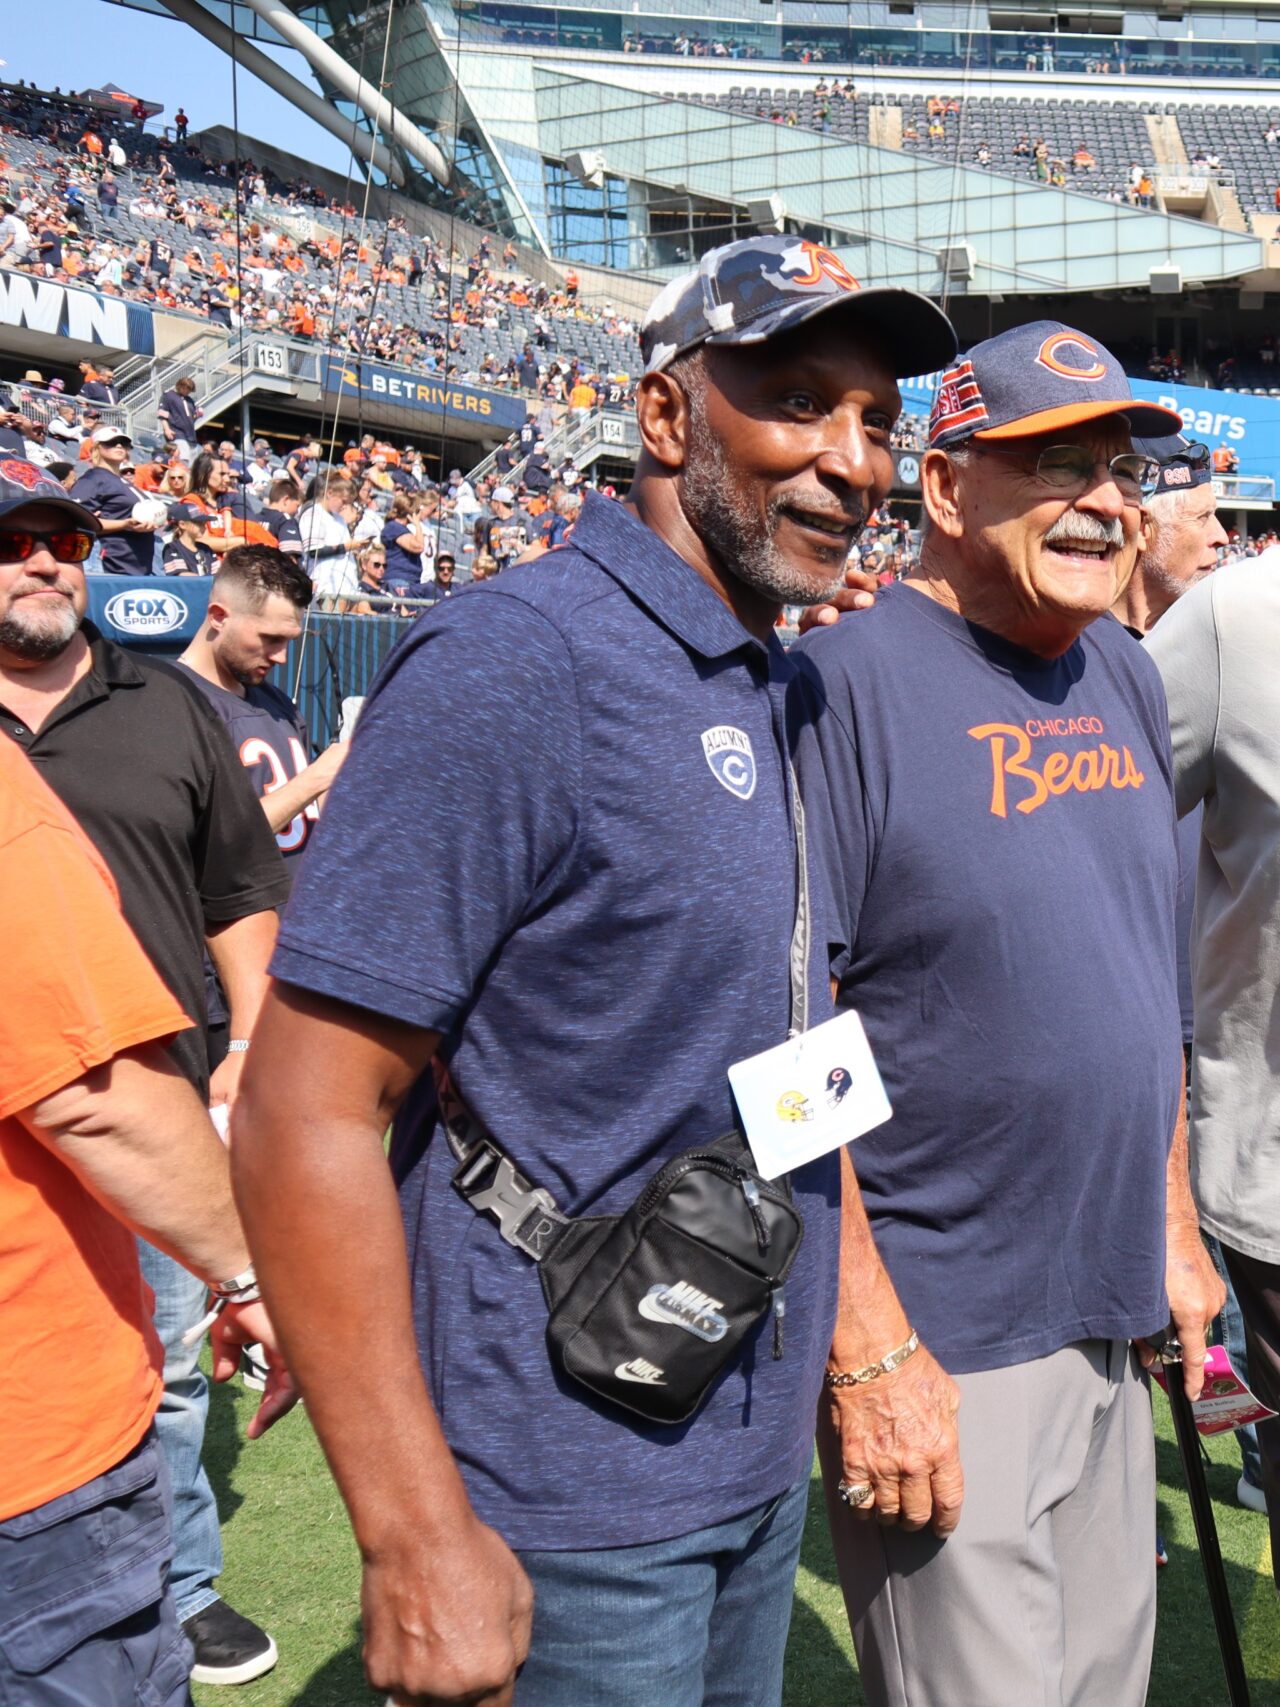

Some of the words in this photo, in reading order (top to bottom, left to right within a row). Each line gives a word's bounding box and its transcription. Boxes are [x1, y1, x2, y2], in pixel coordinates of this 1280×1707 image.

[157, 247, 171, 263] 54
[258, 346, 282, 369] 153
[1034, 331, 1108, 382] C
[371, 373, 492, 416] BETRIVERS
[934, 383, 962, 418] SH
[604, 423, 620, 437] 154
[123, 600, 168, 617] FOX
[123, 616, 171, 626] SPORTS
[1025, 715, 1105, 737] CHICAGO
[706, 729, 749, 753] ALUMNI
[722, 755, 748, 786] C
[967, 722, 1145, 819] Bears
[658, 1280, 725, 1316] NIKE
[626, 1356, 666, 1381] NIKE
